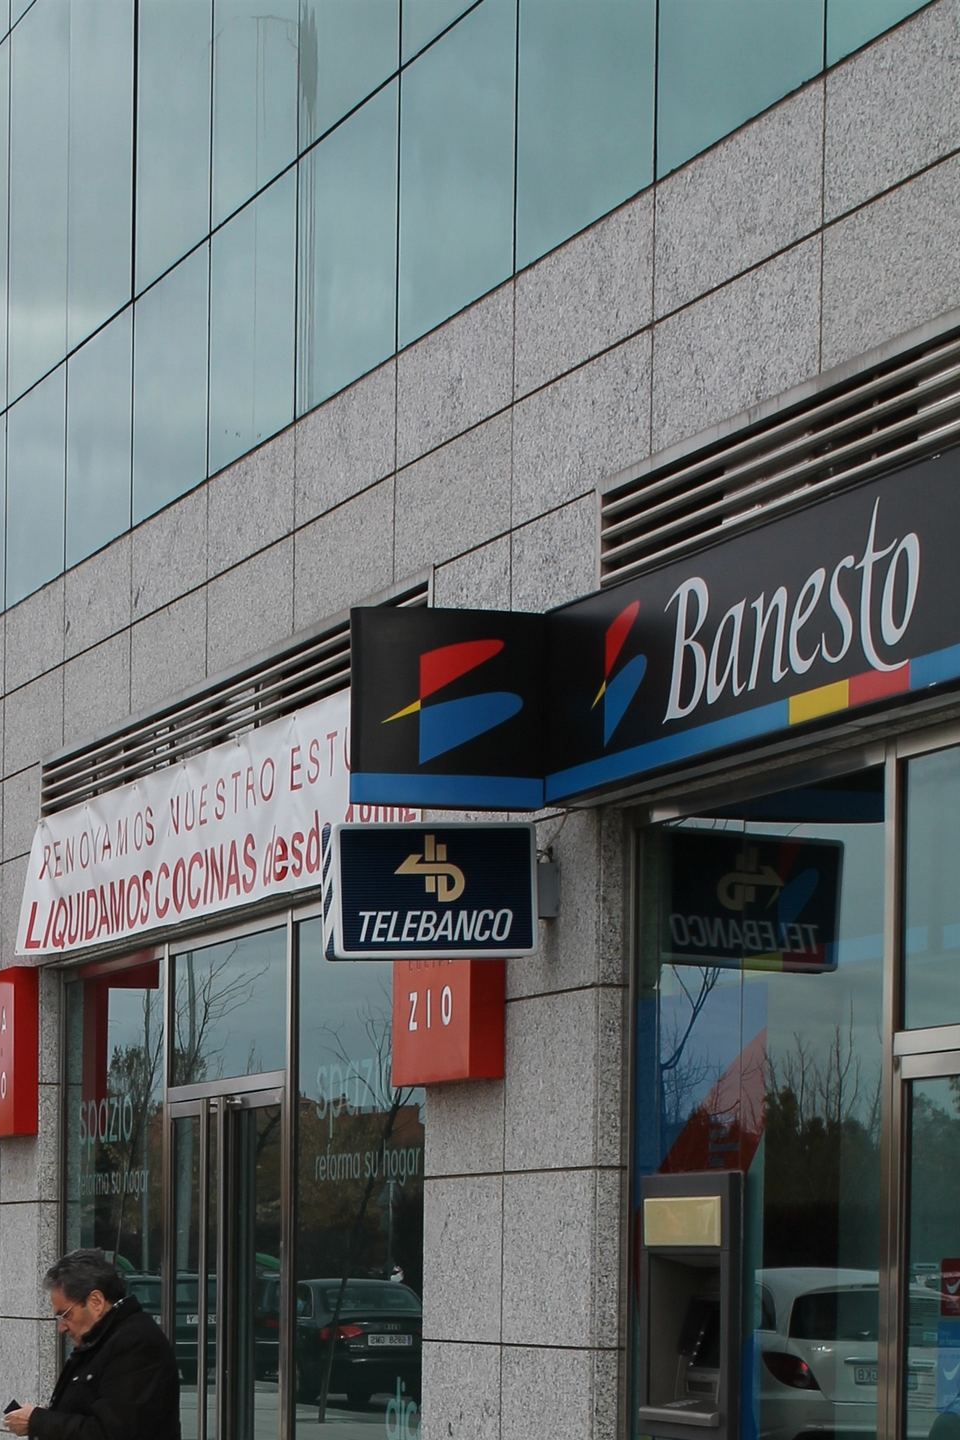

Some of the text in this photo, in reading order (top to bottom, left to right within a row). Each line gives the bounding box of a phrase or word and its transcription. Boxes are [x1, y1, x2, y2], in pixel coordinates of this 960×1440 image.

[662, 496, 920, 724] Banesto
[168, 757, 275, 836] NUESTRO
[24, 809, 324, 950] LIQUIDAMOS COCINAS desd
[358, 907, 514, 943] TELEBANCO
[407, 984, 453, 1032] ZIO
[79, 1093, 134, 1162] spazio
[315, 1138, 421, 1187] reforma su hogar
